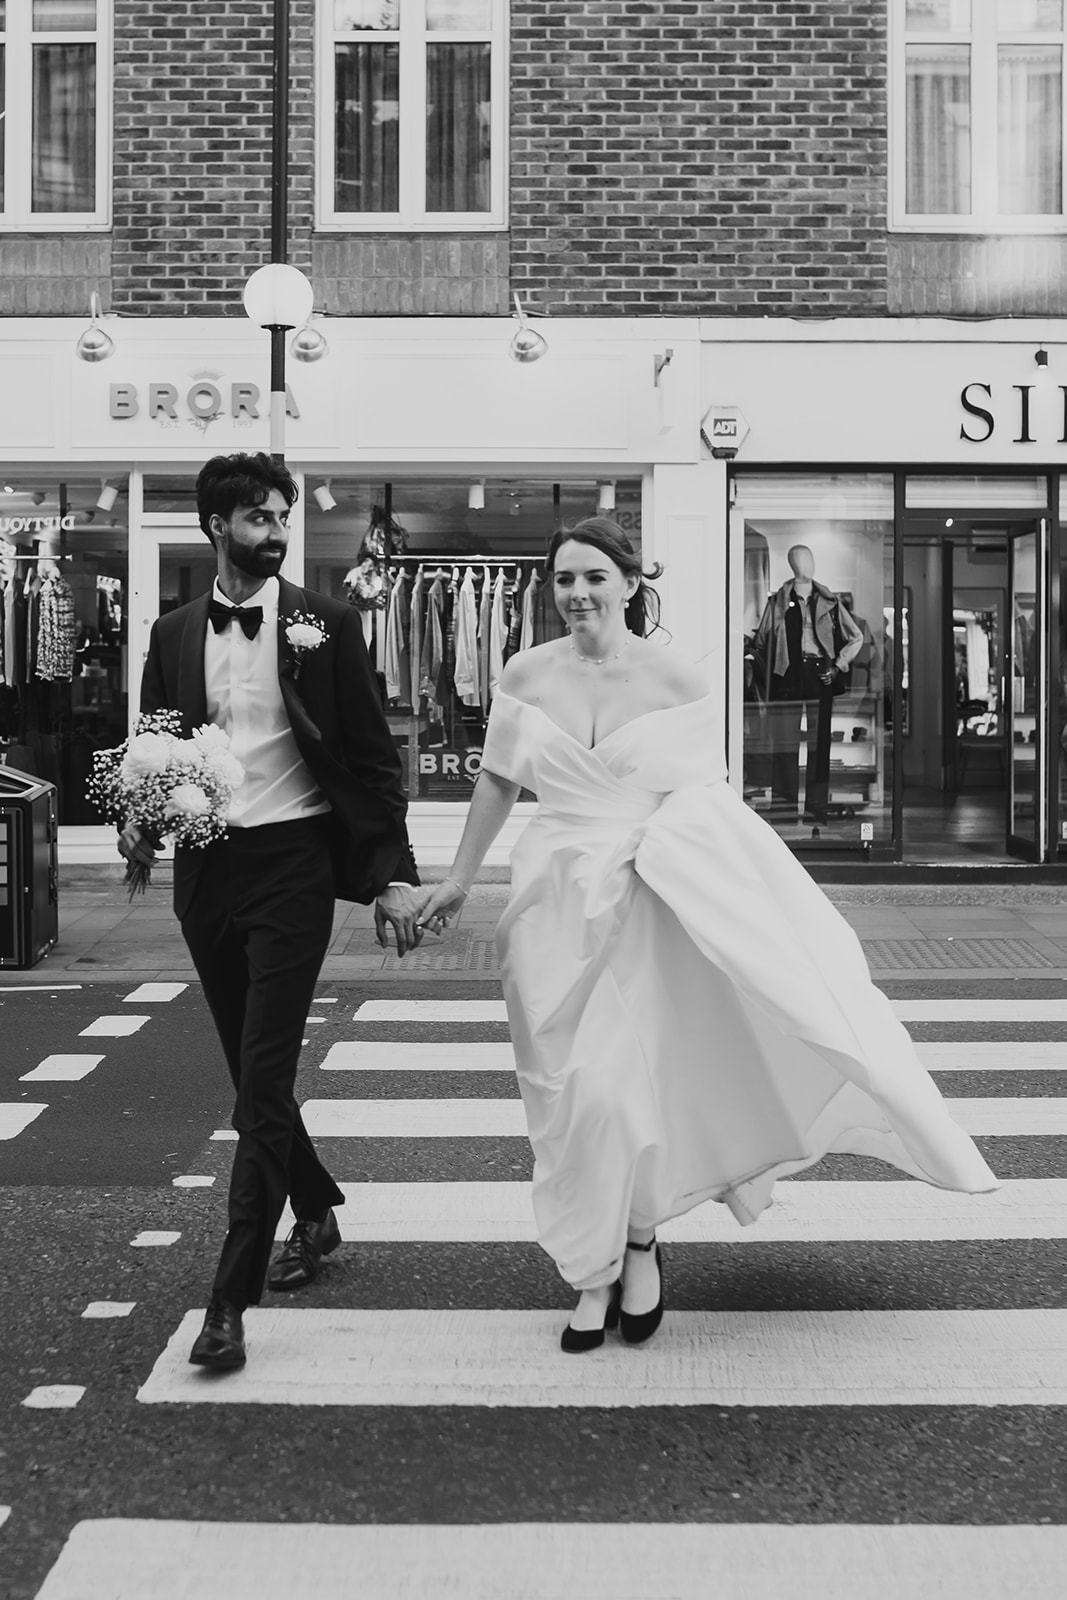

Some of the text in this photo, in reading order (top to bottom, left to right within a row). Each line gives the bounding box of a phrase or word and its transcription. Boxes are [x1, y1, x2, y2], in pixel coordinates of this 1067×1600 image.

[109, 382, 300, 419] BRORA
[960, 382, 1067, 443] SI
[713, 420, 736, 434] ADT
